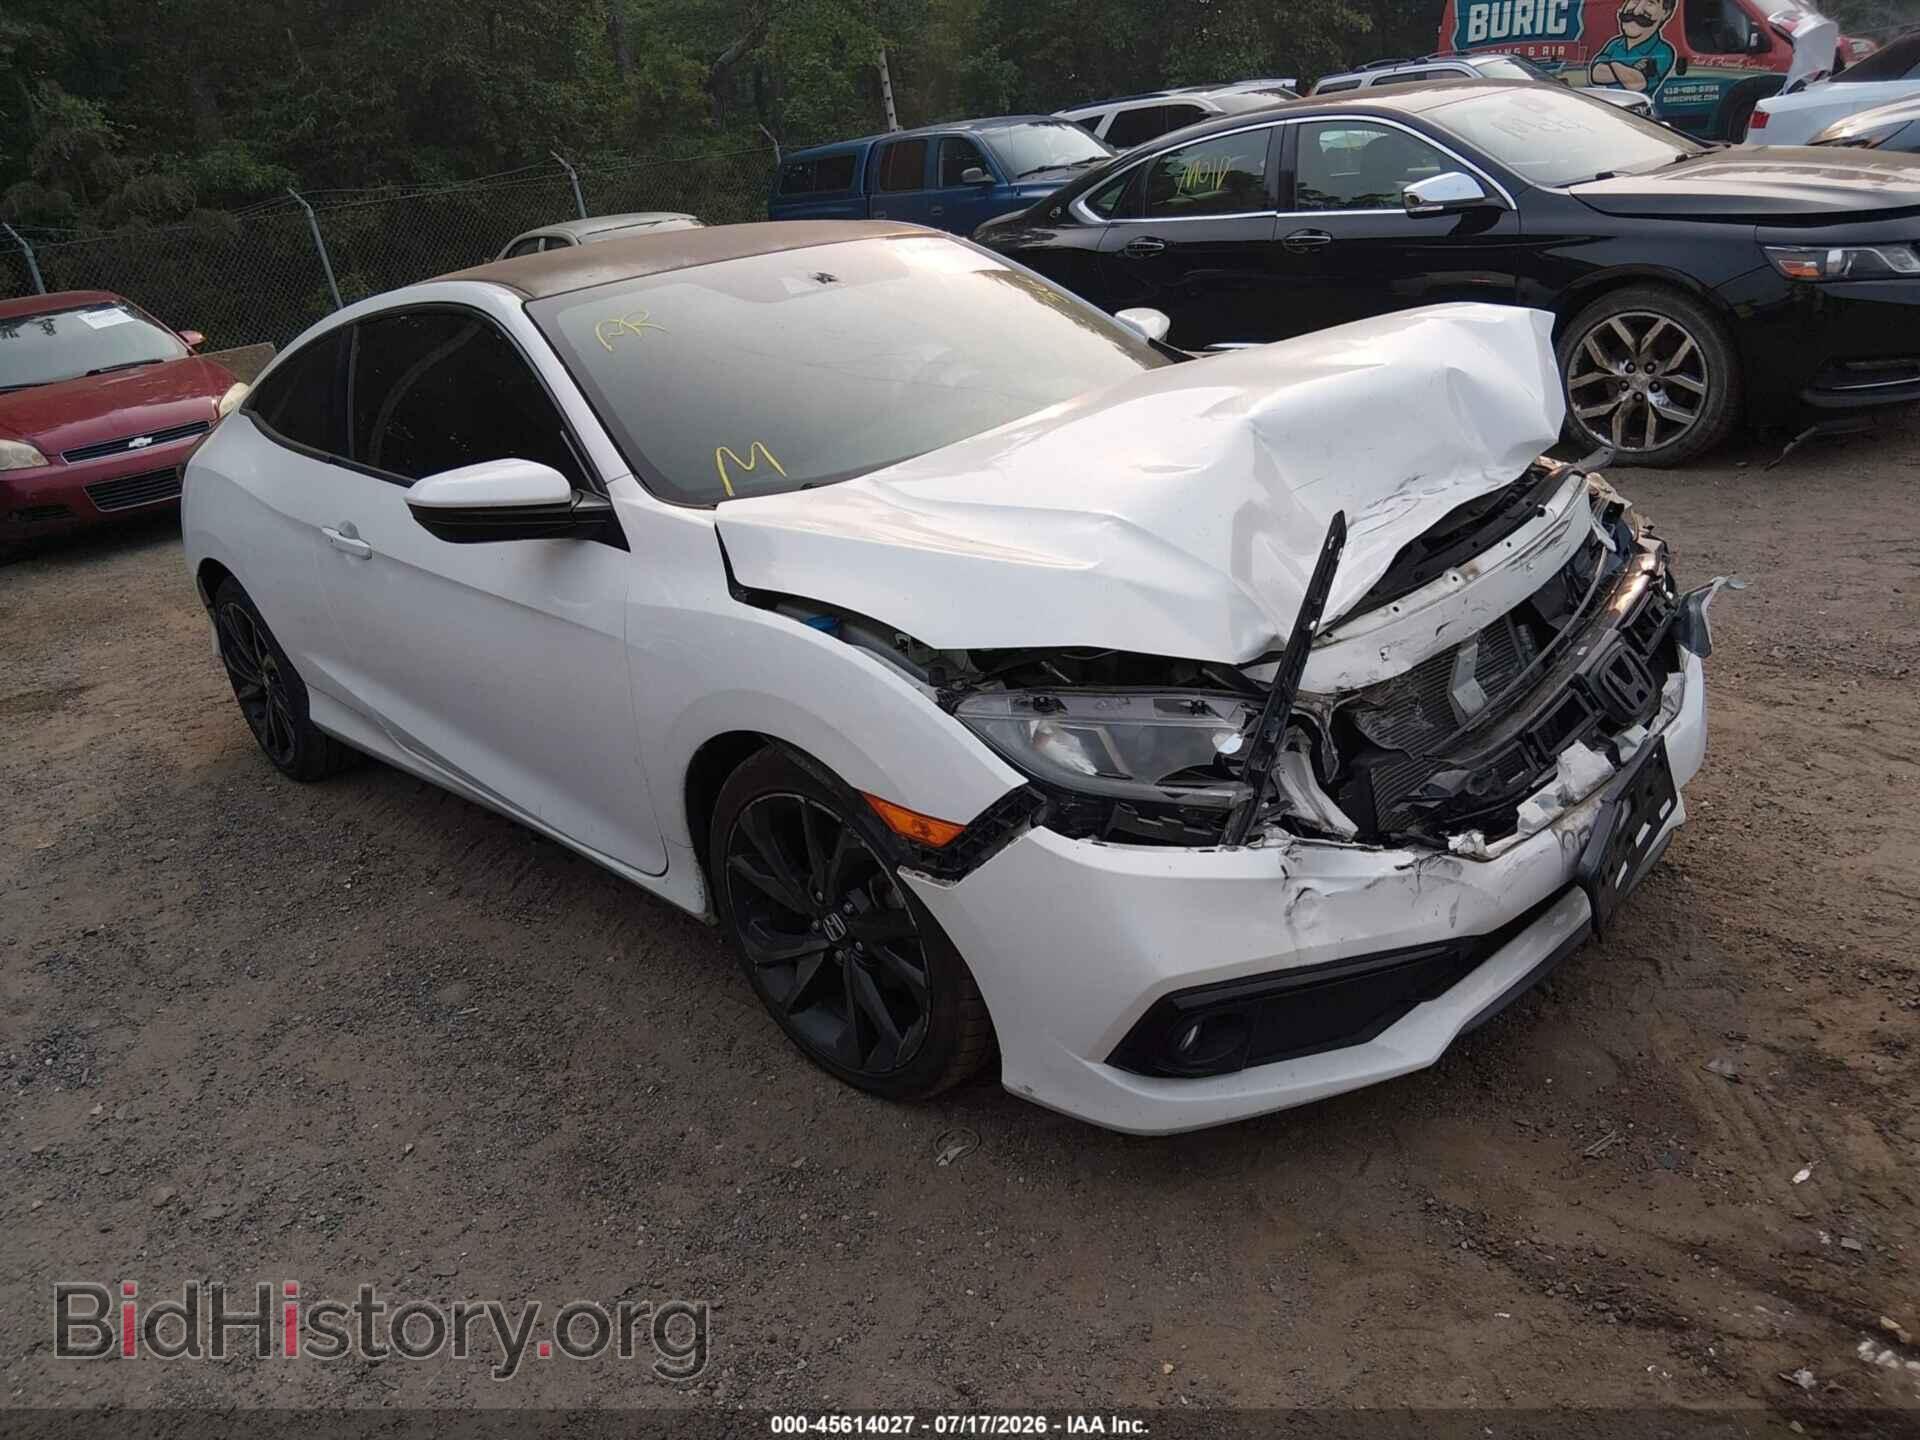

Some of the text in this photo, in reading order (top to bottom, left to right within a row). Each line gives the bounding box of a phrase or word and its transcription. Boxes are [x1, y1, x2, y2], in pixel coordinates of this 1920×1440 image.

[1467, 0, 1568, 42] BURIC
[1542, 46, 1566, 56] AIR
[716, 441, 788, 497] M
